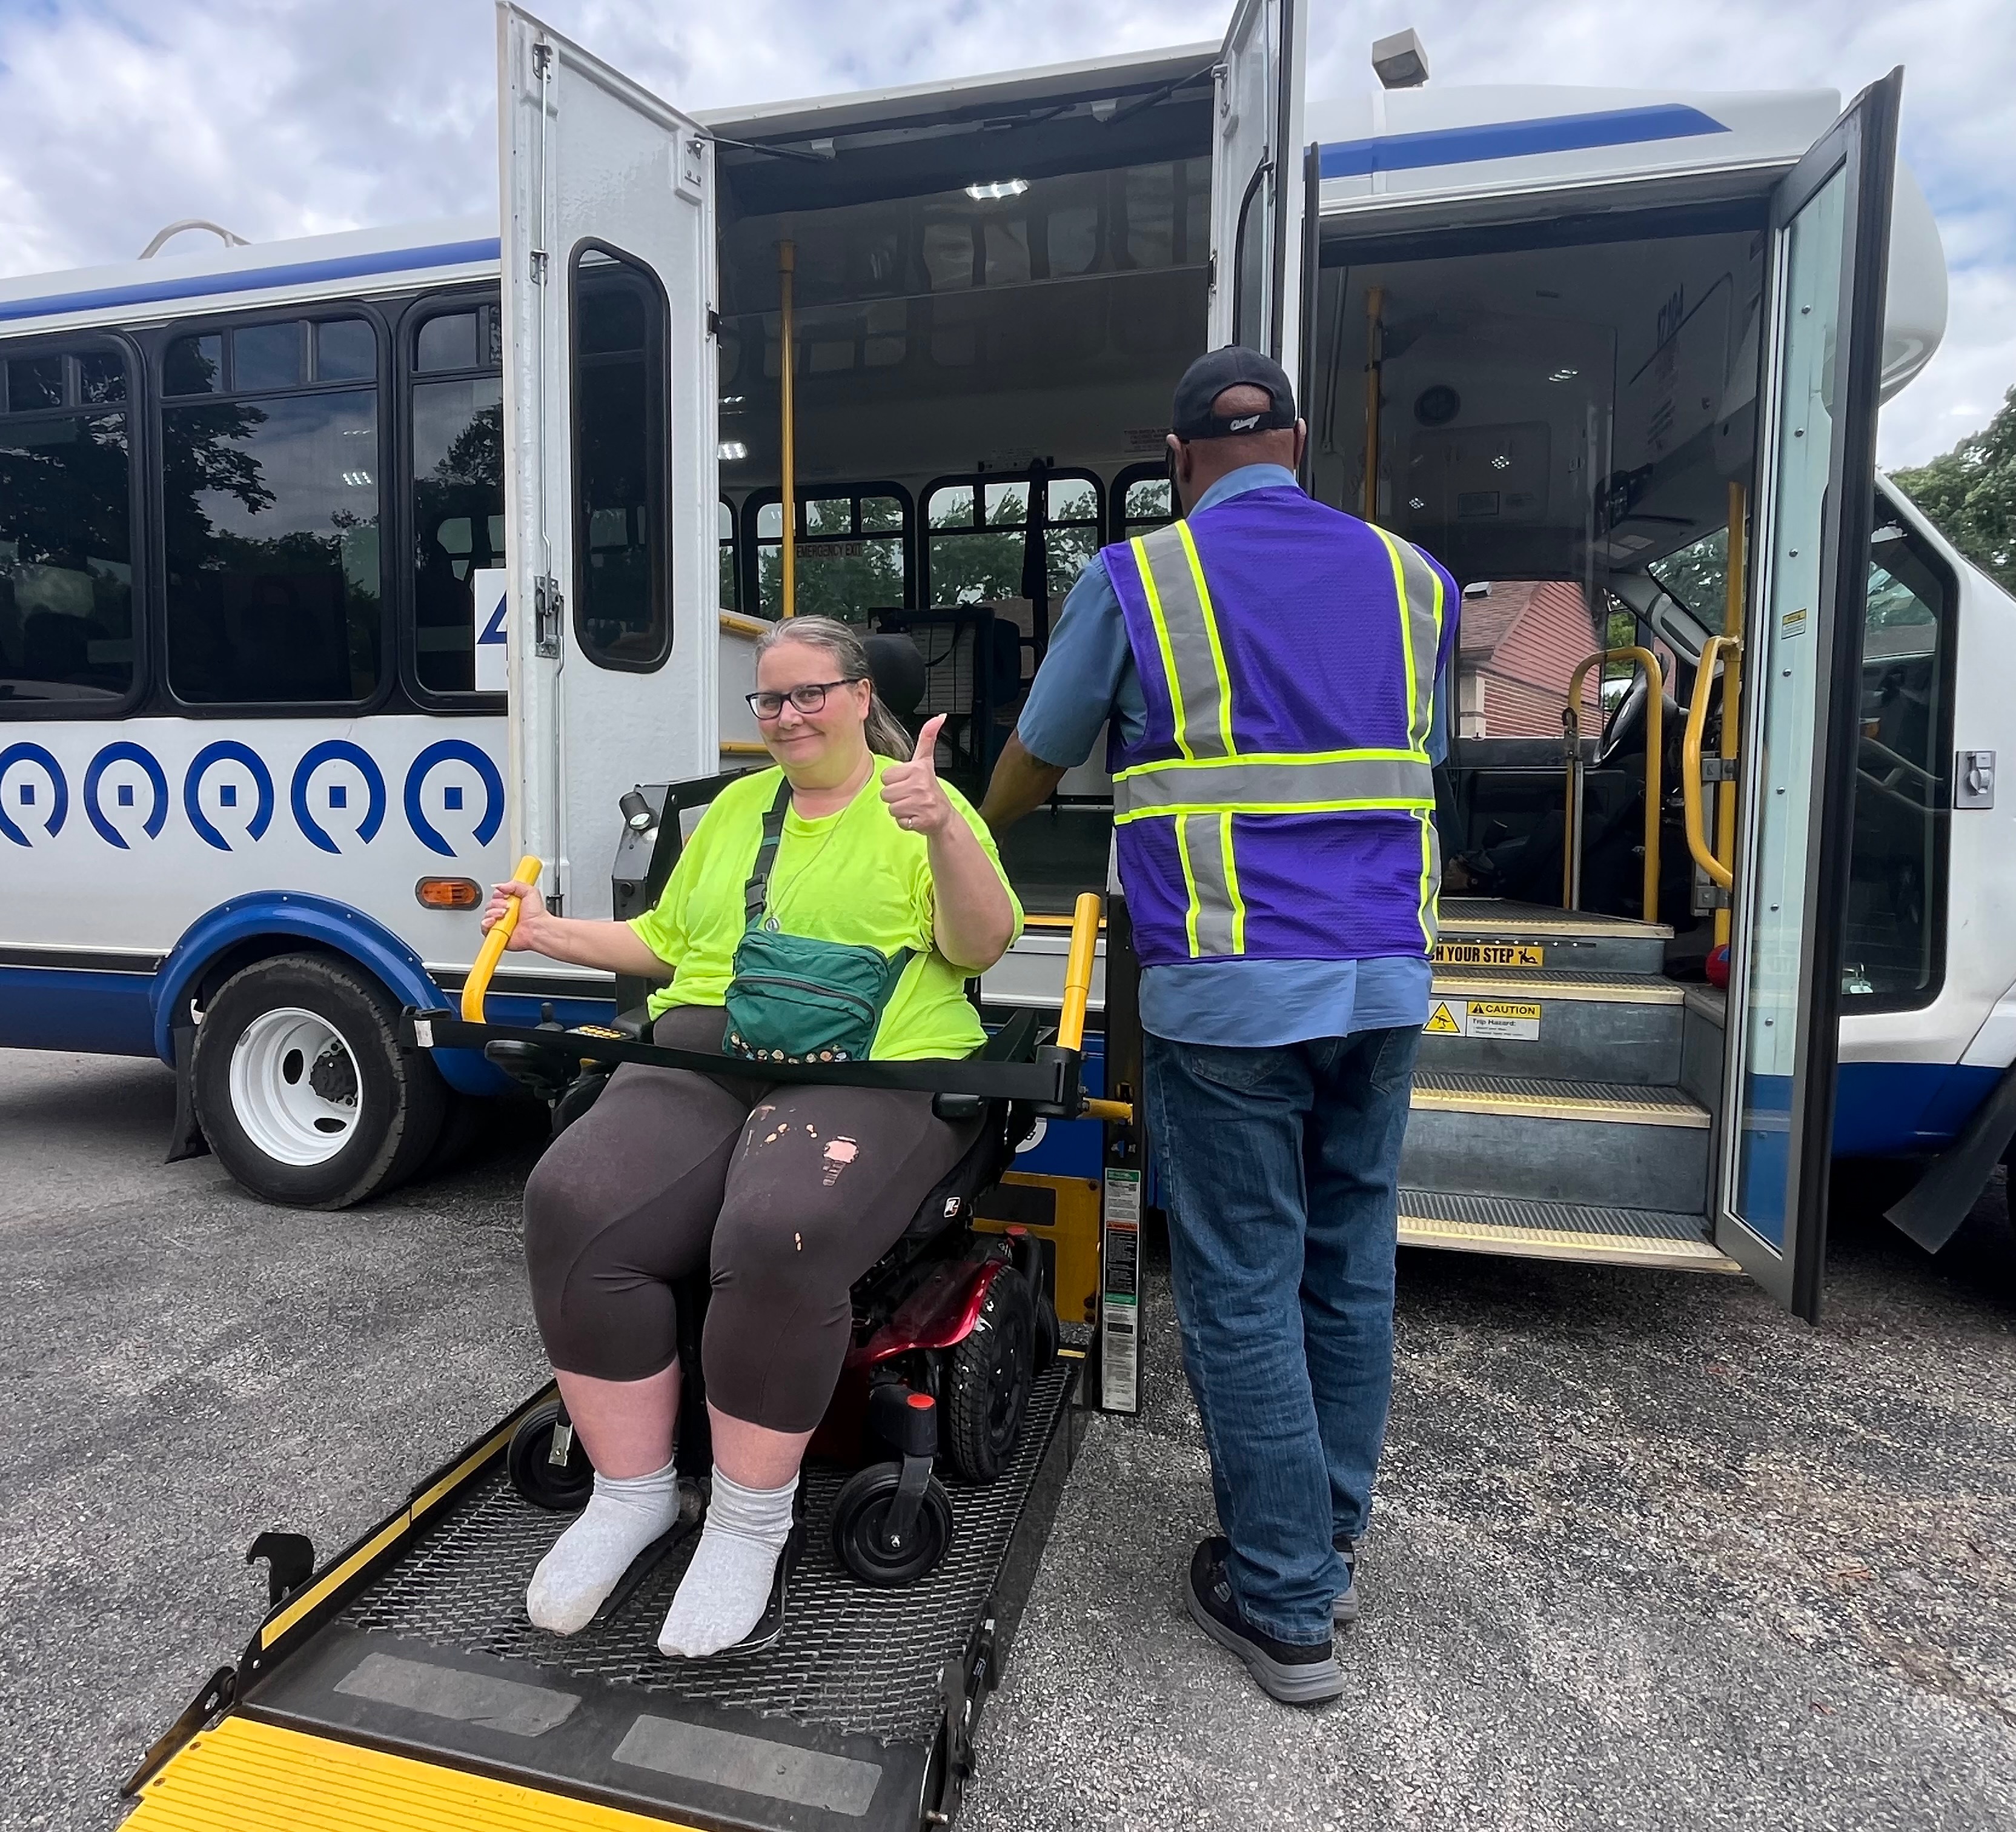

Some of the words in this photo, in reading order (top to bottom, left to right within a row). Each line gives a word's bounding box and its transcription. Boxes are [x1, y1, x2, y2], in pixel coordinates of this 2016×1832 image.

[846, 543, 863, 557] EXIT
[1447, 946, 1480, 962] YOUR
[1484, 947, 1514, 963] STEP
[1485, 1004, 1535, 1015] CAUTION
